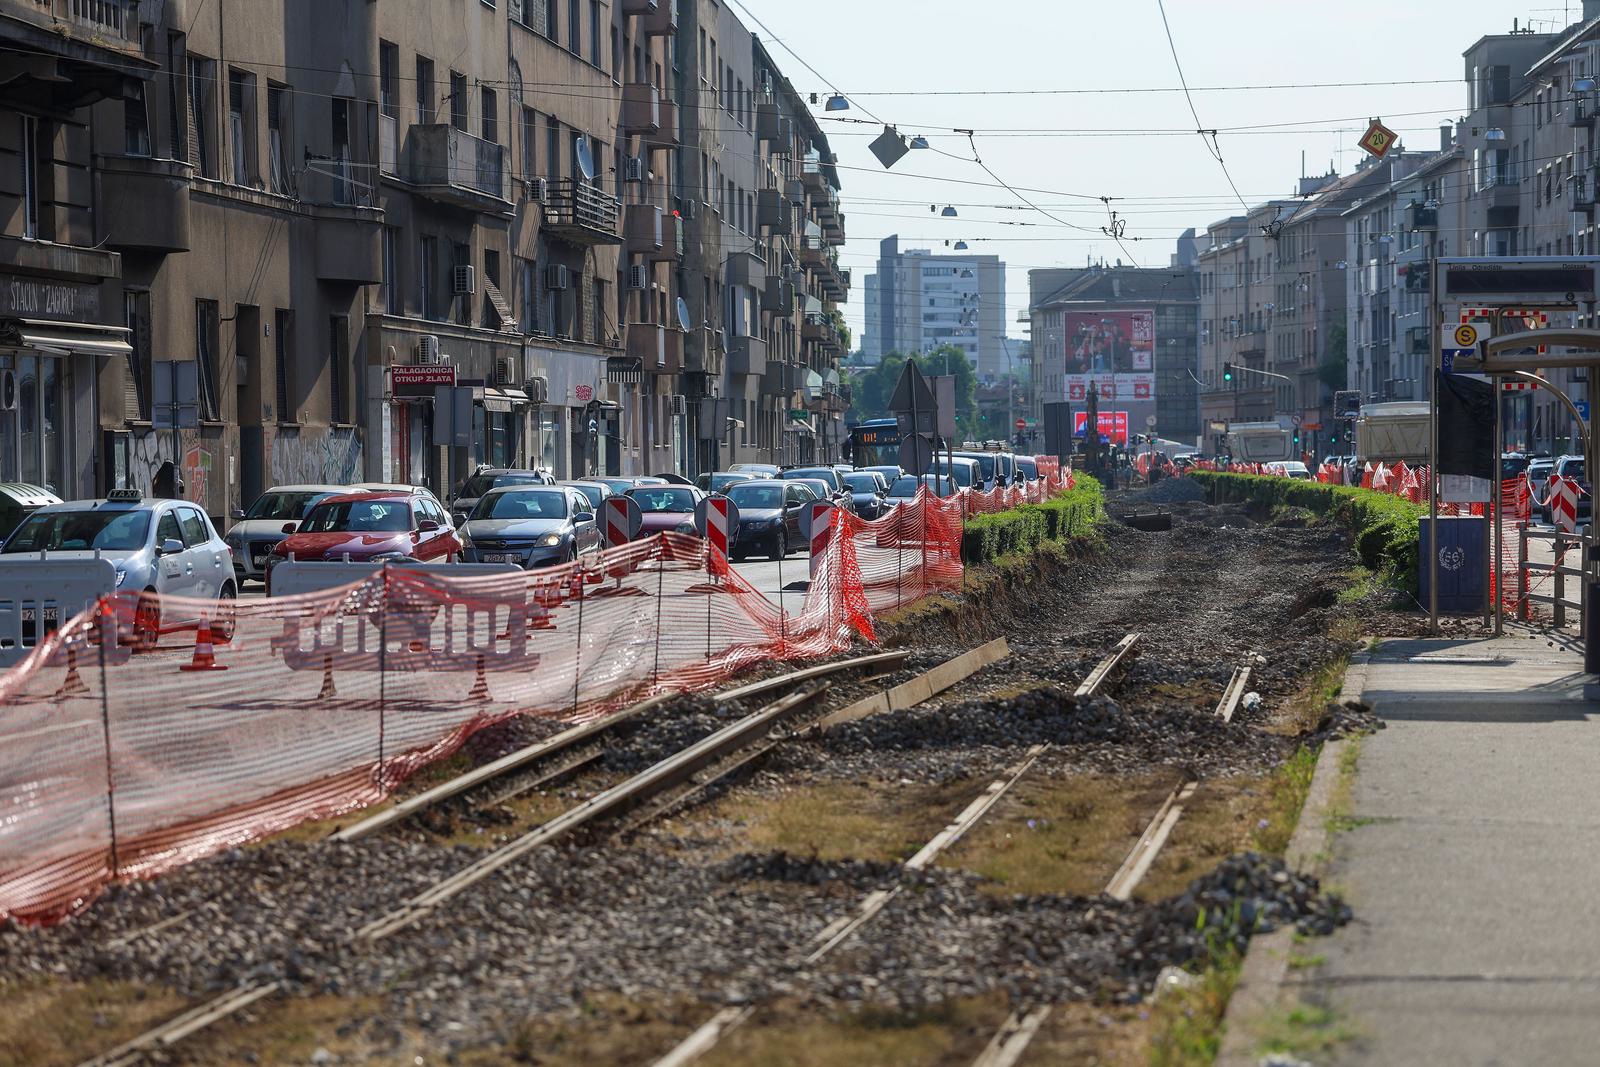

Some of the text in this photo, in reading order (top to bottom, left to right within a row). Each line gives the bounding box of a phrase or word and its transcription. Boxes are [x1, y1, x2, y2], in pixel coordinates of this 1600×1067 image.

[1372, 133, 1384, 146] 20
[1460, 330, 1472, 343] S
[393, 367, 453, 375] ZALAGAONICA
[394, 375, 424, 383] OTKUP
[112, 490, 138, 498] TAXI
